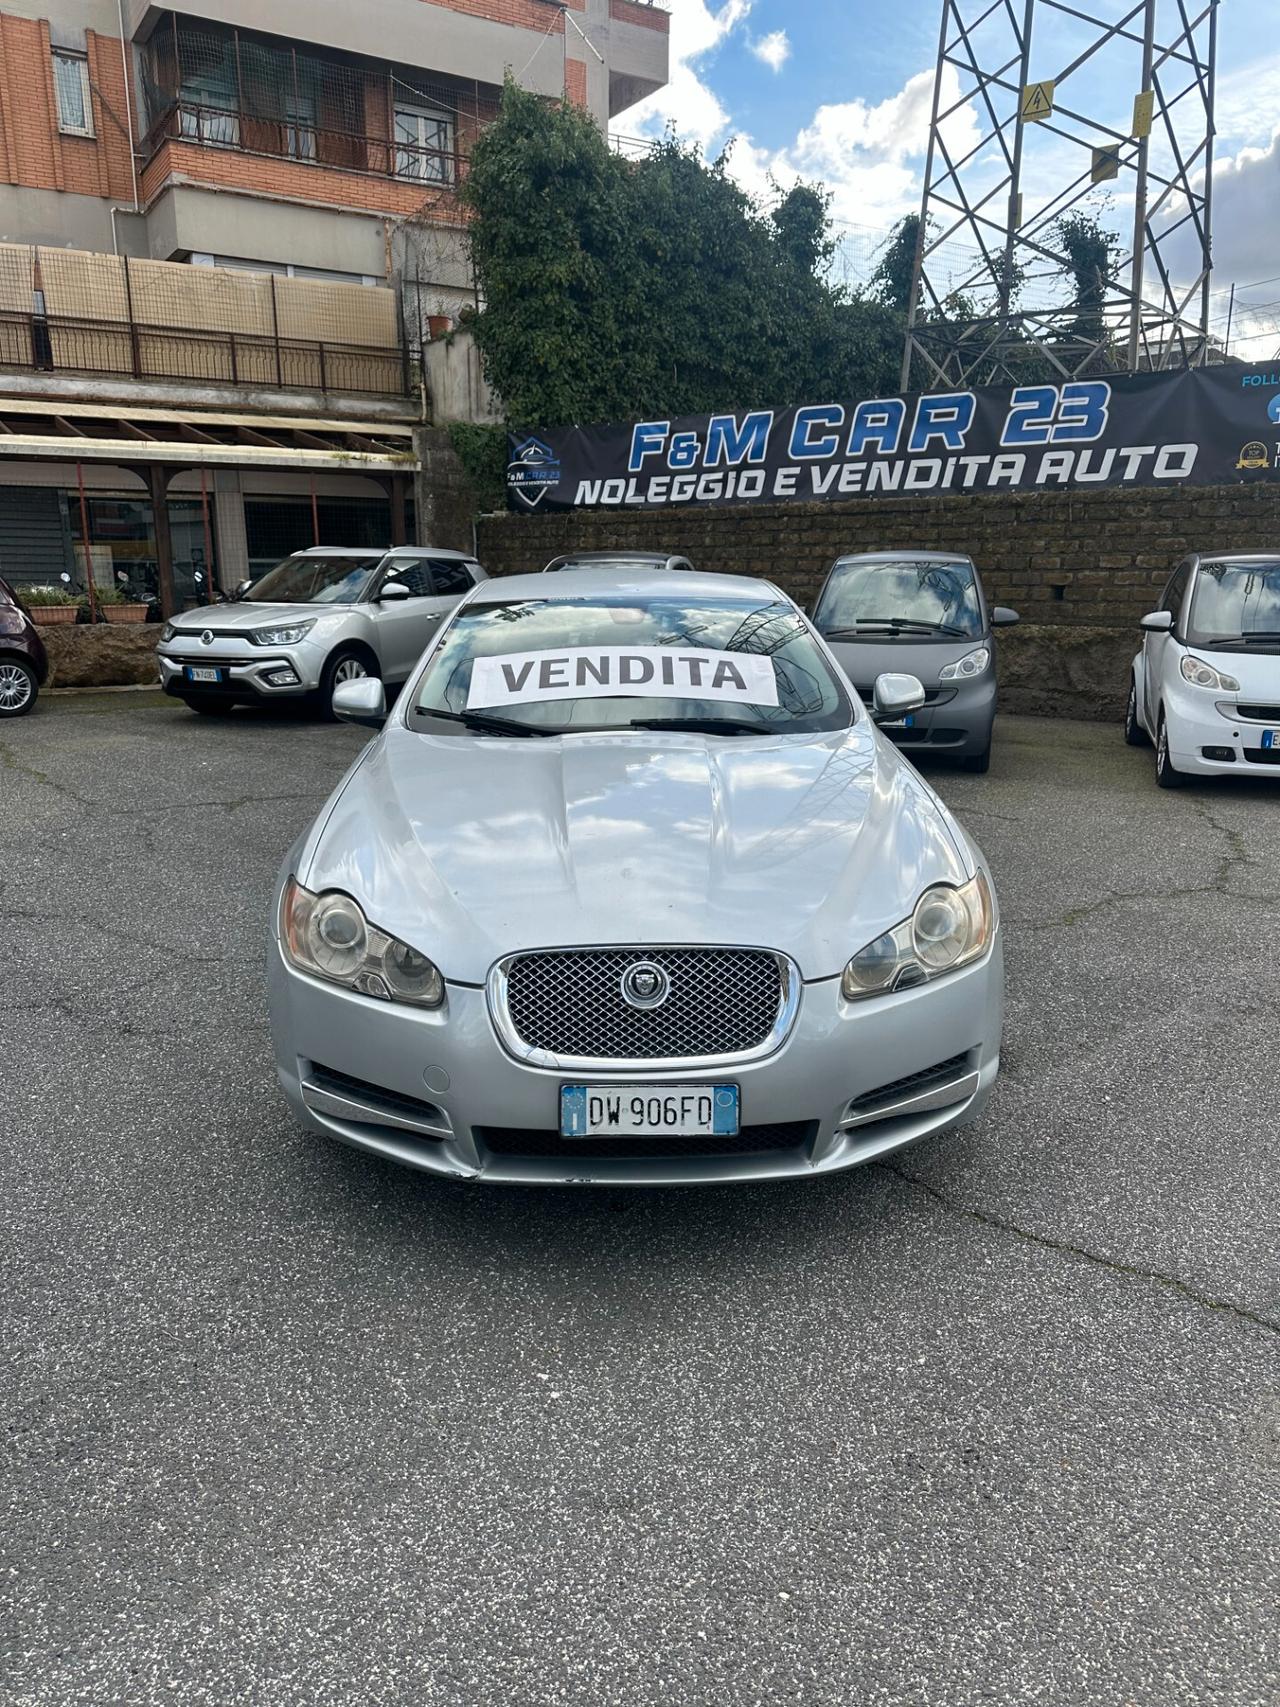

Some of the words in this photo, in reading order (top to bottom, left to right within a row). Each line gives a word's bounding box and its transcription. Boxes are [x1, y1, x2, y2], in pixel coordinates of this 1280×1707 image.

[1242, 374, 1280, 388] FOLL
[628, 410, 775, 472] F&M
[787, 390, 977, 461] CAR
[1000, 380, 1112, 447] 23
[573, 469, 766, 505] NOLEGGIO
[773, 466, 801, 496] E
[810, 453, 1027, 495] VENDITA
[1035, 443, 1199, 484] AUTO
[501, 655, 747, 693] VENDITA
